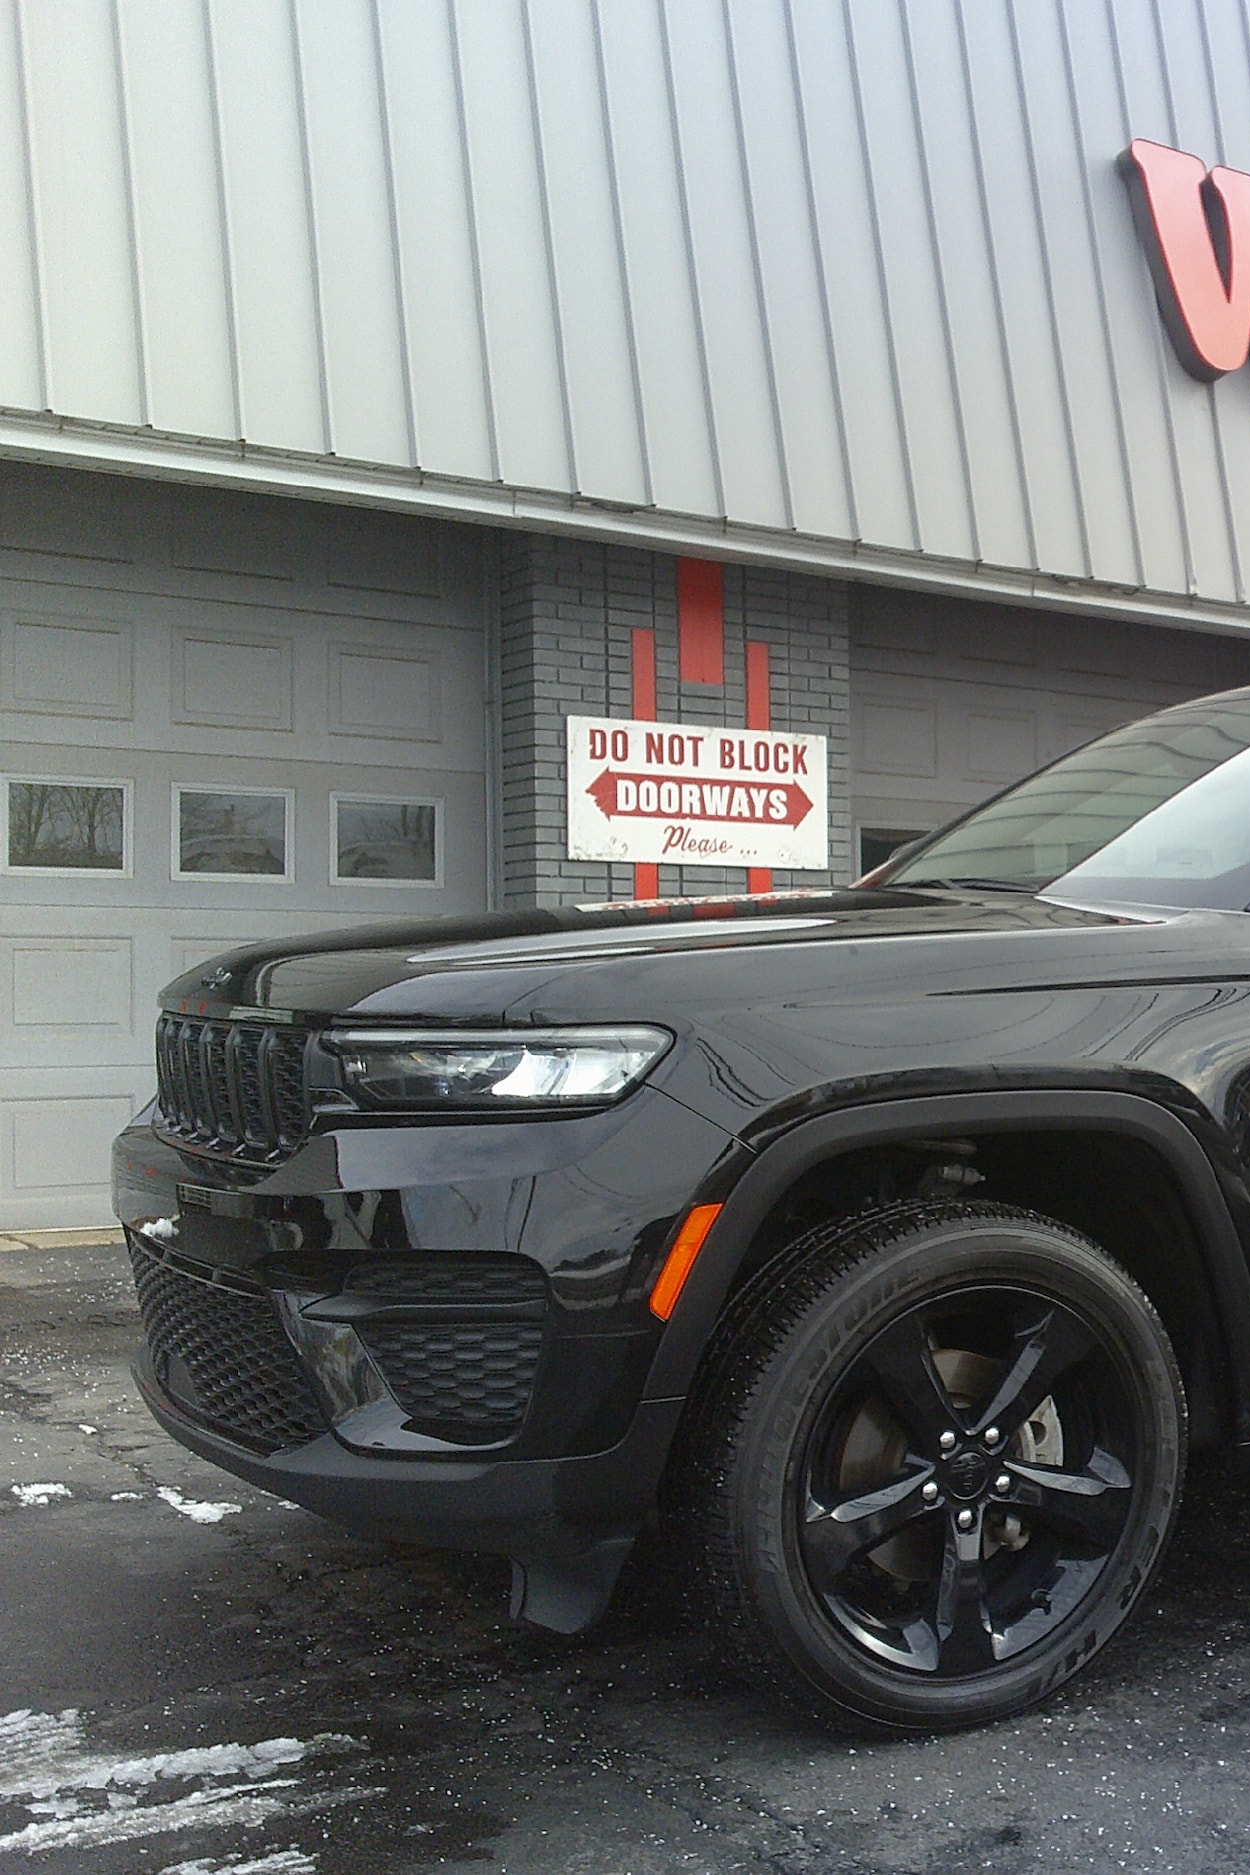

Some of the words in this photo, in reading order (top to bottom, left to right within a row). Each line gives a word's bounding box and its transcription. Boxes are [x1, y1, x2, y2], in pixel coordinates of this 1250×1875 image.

[589, 728, 629, 763] DO
[645, 732, 705, 767] NOT
[719, 738, 809, 775] BLOCK
[615, 778, 788, 820] DOORWAYS
[662, 825, 733, 855] Please
